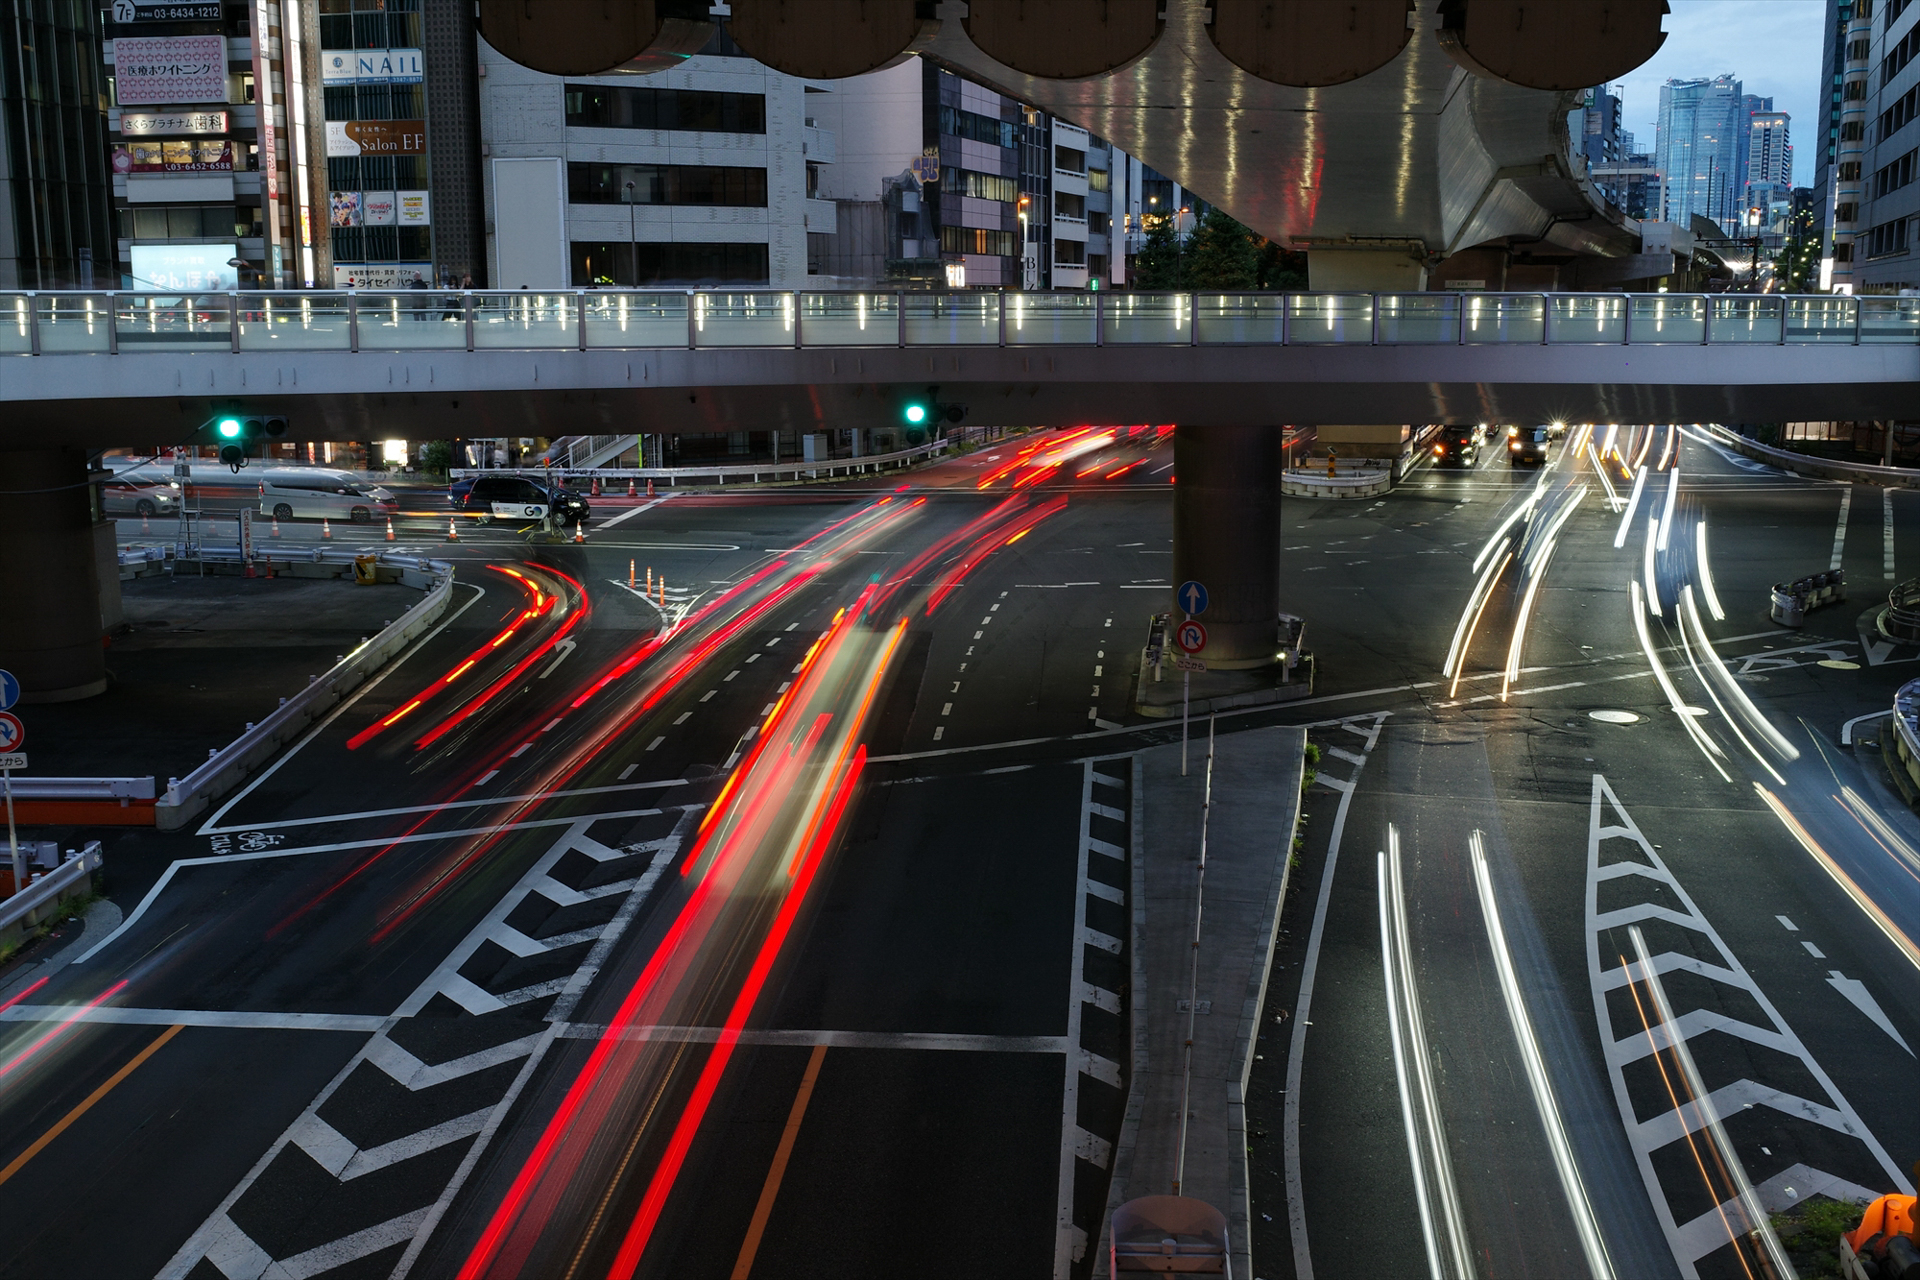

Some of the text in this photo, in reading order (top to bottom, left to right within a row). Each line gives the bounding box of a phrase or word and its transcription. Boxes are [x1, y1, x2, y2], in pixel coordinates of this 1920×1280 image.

[154, 7, 219, 19] 03-6434-1212
[127, 63, 211, 77] 医療ホワイトニング
[360, 57, 421, 74] NAIL
[125, 114, 223, 130] さくらプラチナム歯科
[361, 133, 424, 151] Salon EF
[524, 506, 543, 517] GO
[1177, 660, 1205, 671] ここから
